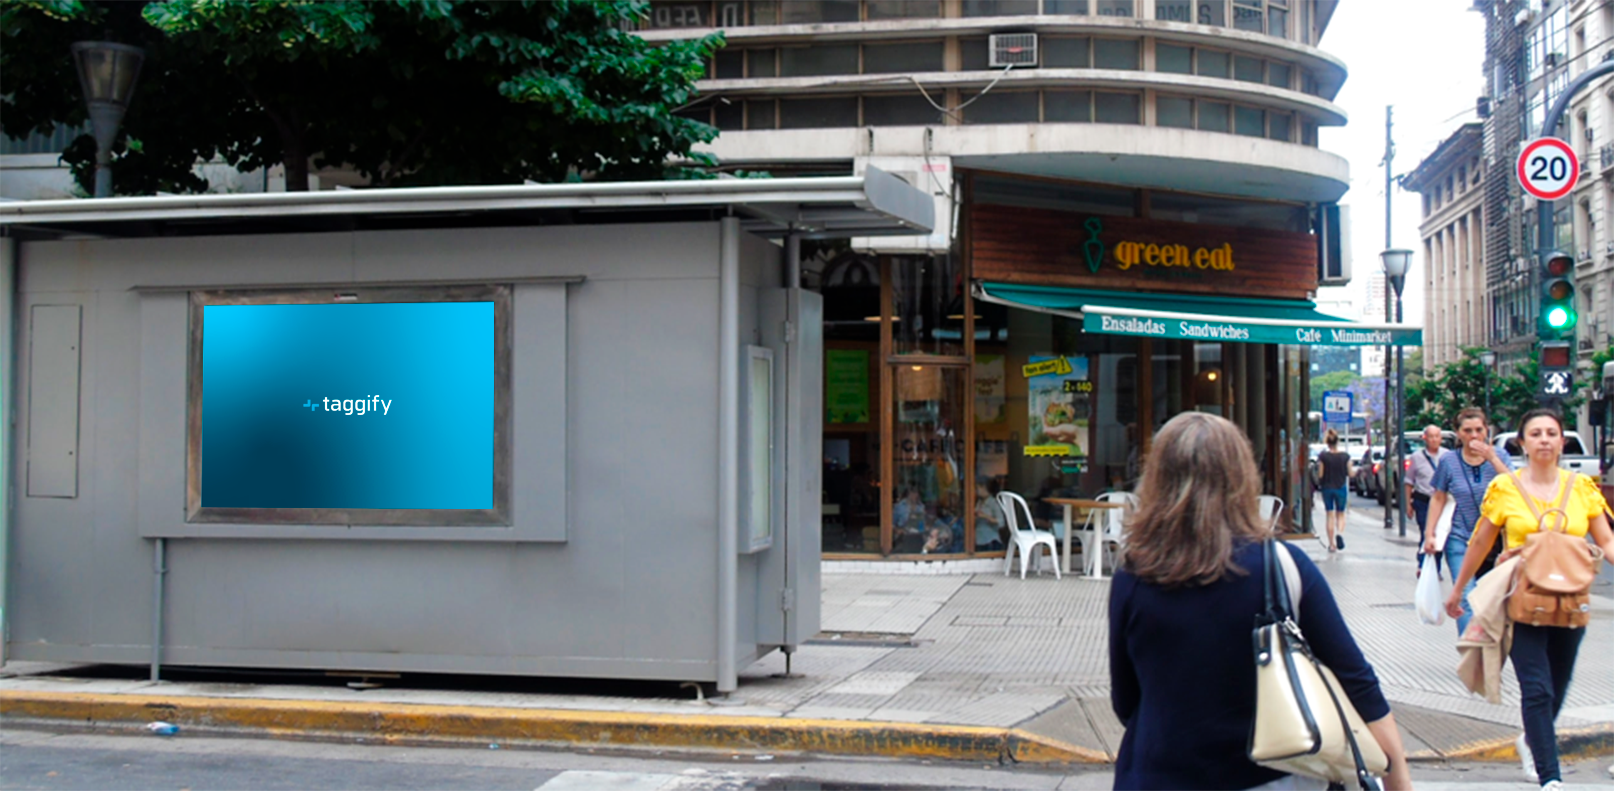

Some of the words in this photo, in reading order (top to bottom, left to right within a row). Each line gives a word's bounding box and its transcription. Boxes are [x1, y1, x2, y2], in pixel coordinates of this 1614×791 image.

[1530, 156, 1567, 181] 20
[1114, 240, 1191, 270] green
[1193, 242, 1235, 271] eat
[1101, 315, 1166, 335] Ensaladas
[1179, 321, 1249, 340] Sandwiches
[1331, 328, 1392, 344] Minimarket
[322, 394, 393, 416] taggify
